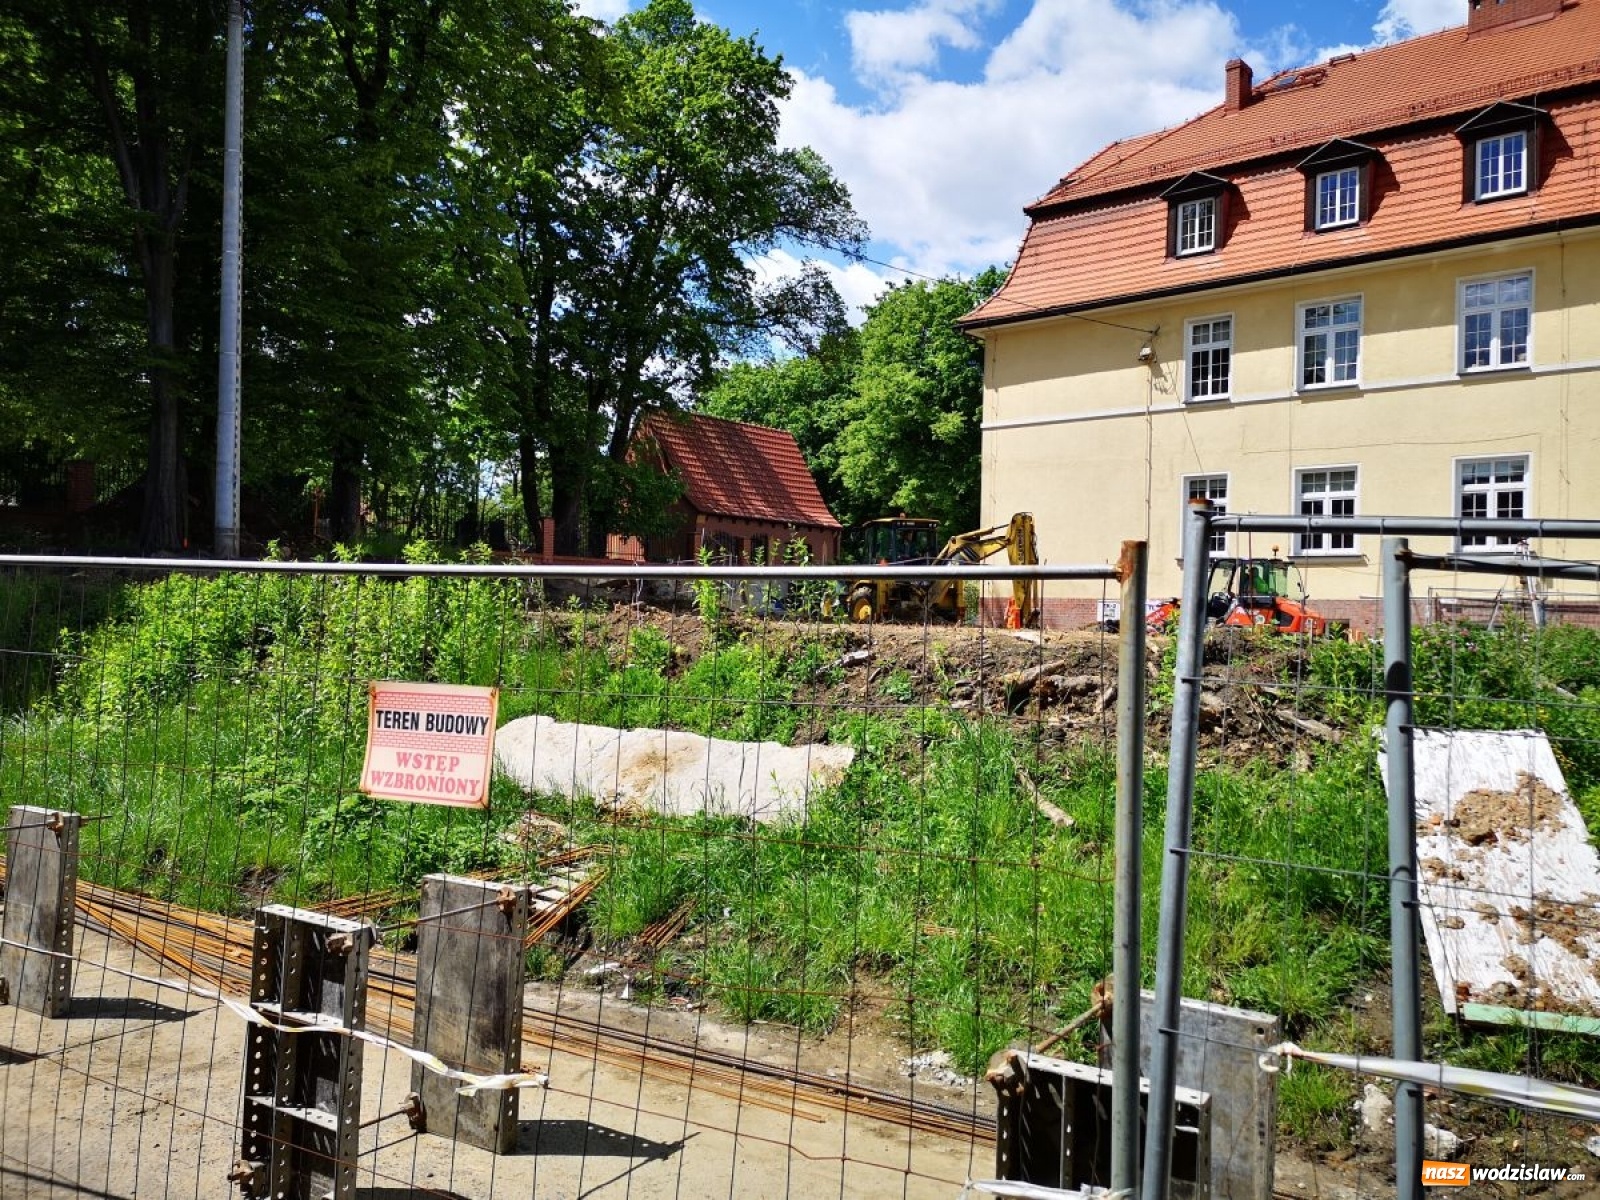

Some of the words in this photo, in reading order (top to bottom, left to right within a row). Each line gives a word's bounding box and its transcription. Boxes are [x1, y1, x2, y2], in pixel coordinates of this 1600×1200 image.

[376, 710, 420, 731] TEREN
[425, 713, 489, 735] BUDOWY
[396, 752, 460, 774] WSTĘP
[371, 770, 480, 796] WZBRONIONY
